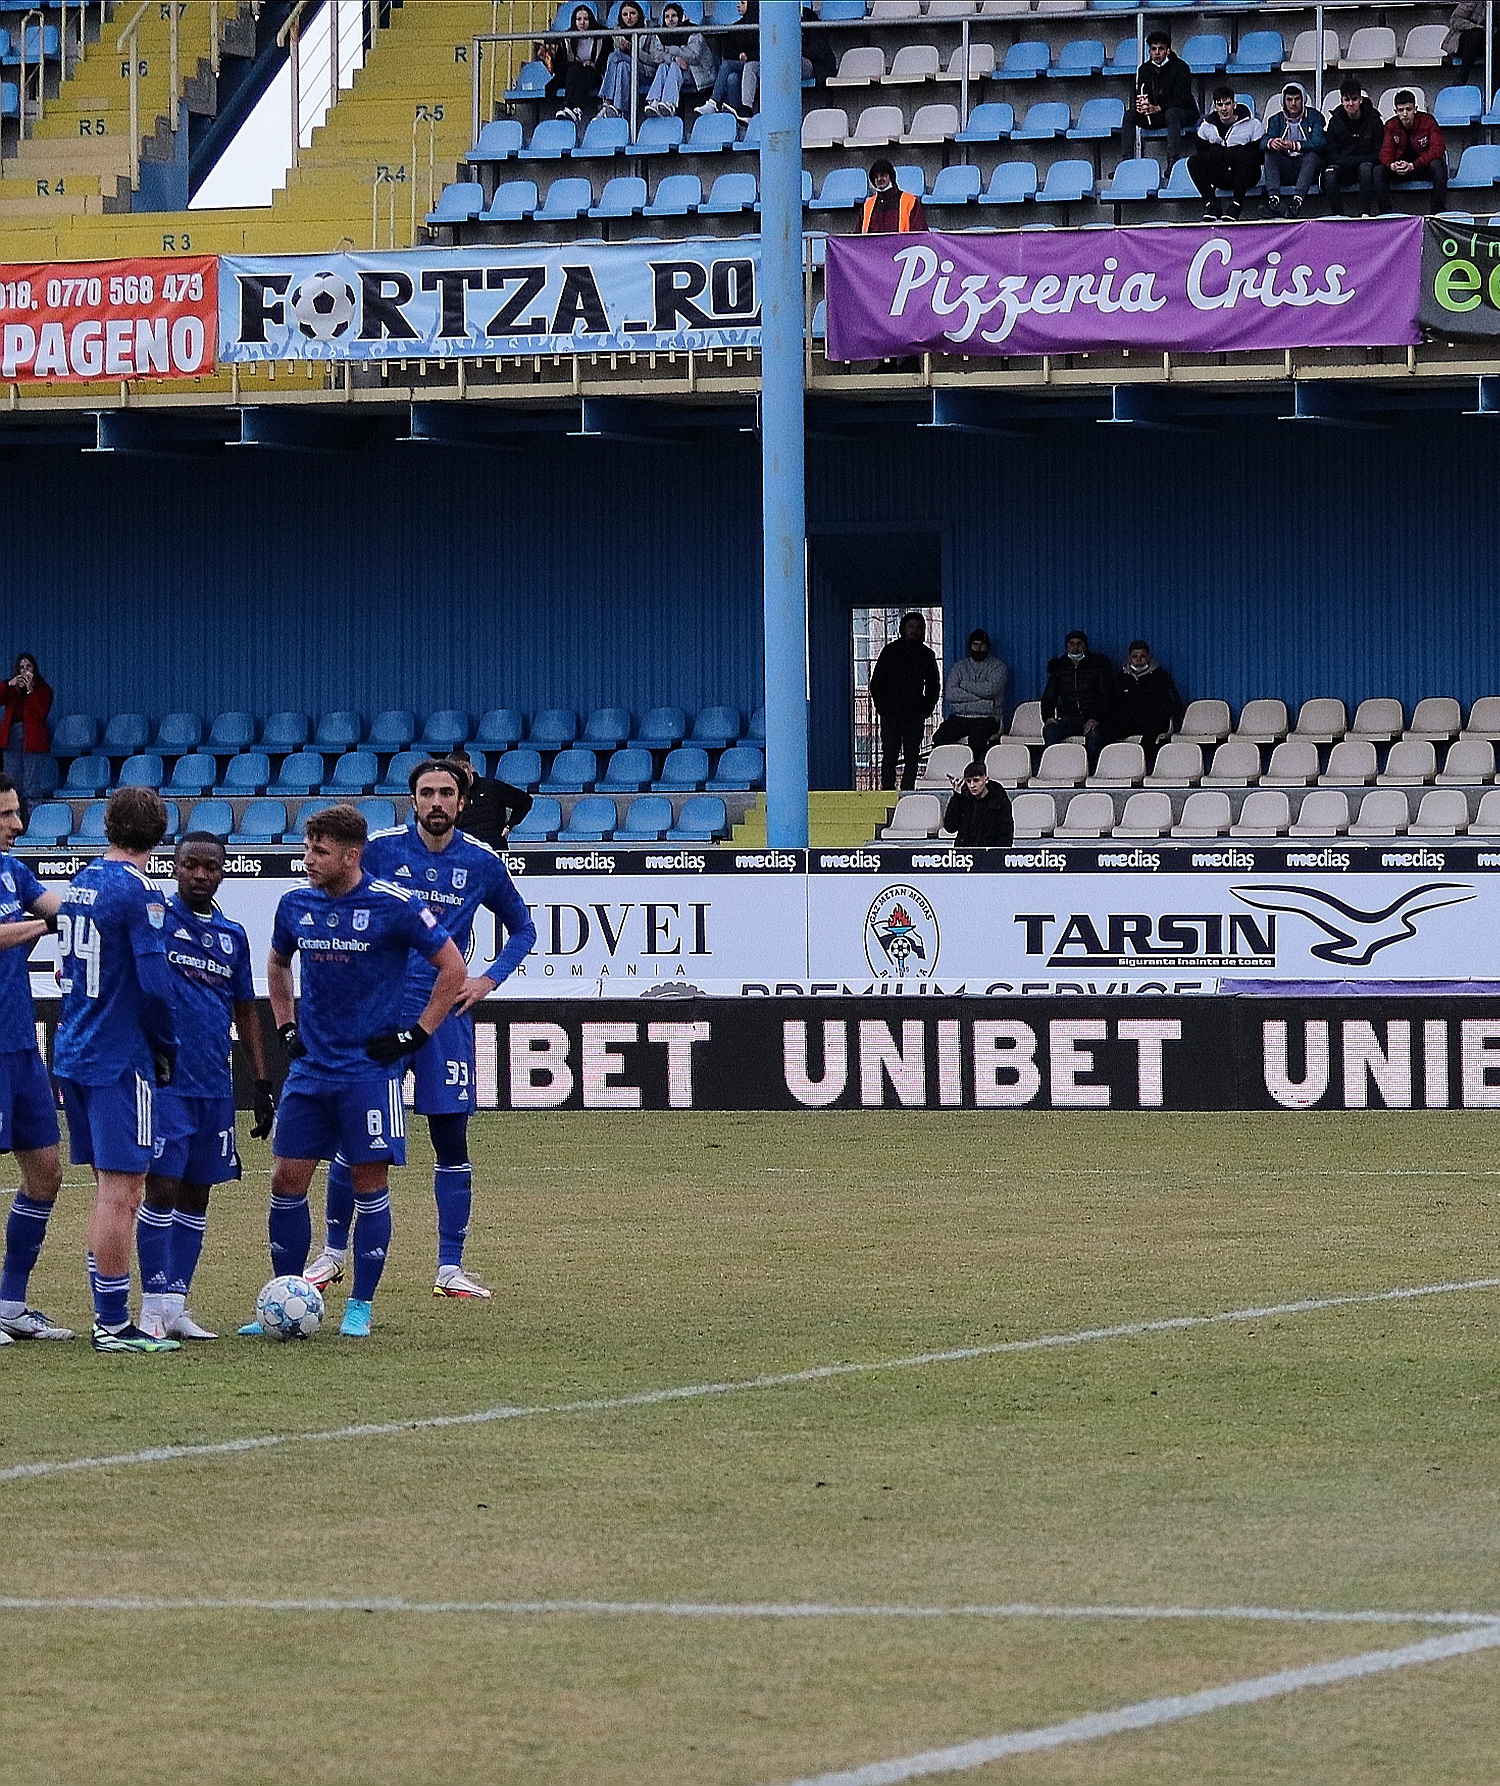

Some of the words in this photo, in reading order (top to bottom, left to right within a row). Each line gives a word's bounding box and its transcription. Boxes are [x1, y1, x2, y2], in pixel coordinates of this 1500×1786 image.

[47, 276, 102, 308] 0770
[110, 274, 154, 306] 568
[162, 272, 204, 302] 473
[890, 243, 1166, 345] Pizzeria
[1186, 237, 1356, 311] Criss
[1, 314, 206, 378] PAGENO
[38, 857, 87, 875] medi
[145, 856, 174, 877] diaș
[878, 888, 907, 906] METAN
[1014, 914, 1277, 955] TARSIN
[1221, 957, 1236, 966] de
[1238, 957, 1272, 966] toate
[445, 1060, 469, 1086] 33
[472, 1018, 712, 1109] IBET
[782, 1018, 1182, 1109] UNIBET
[366, 1109, 382, 1136] 8
